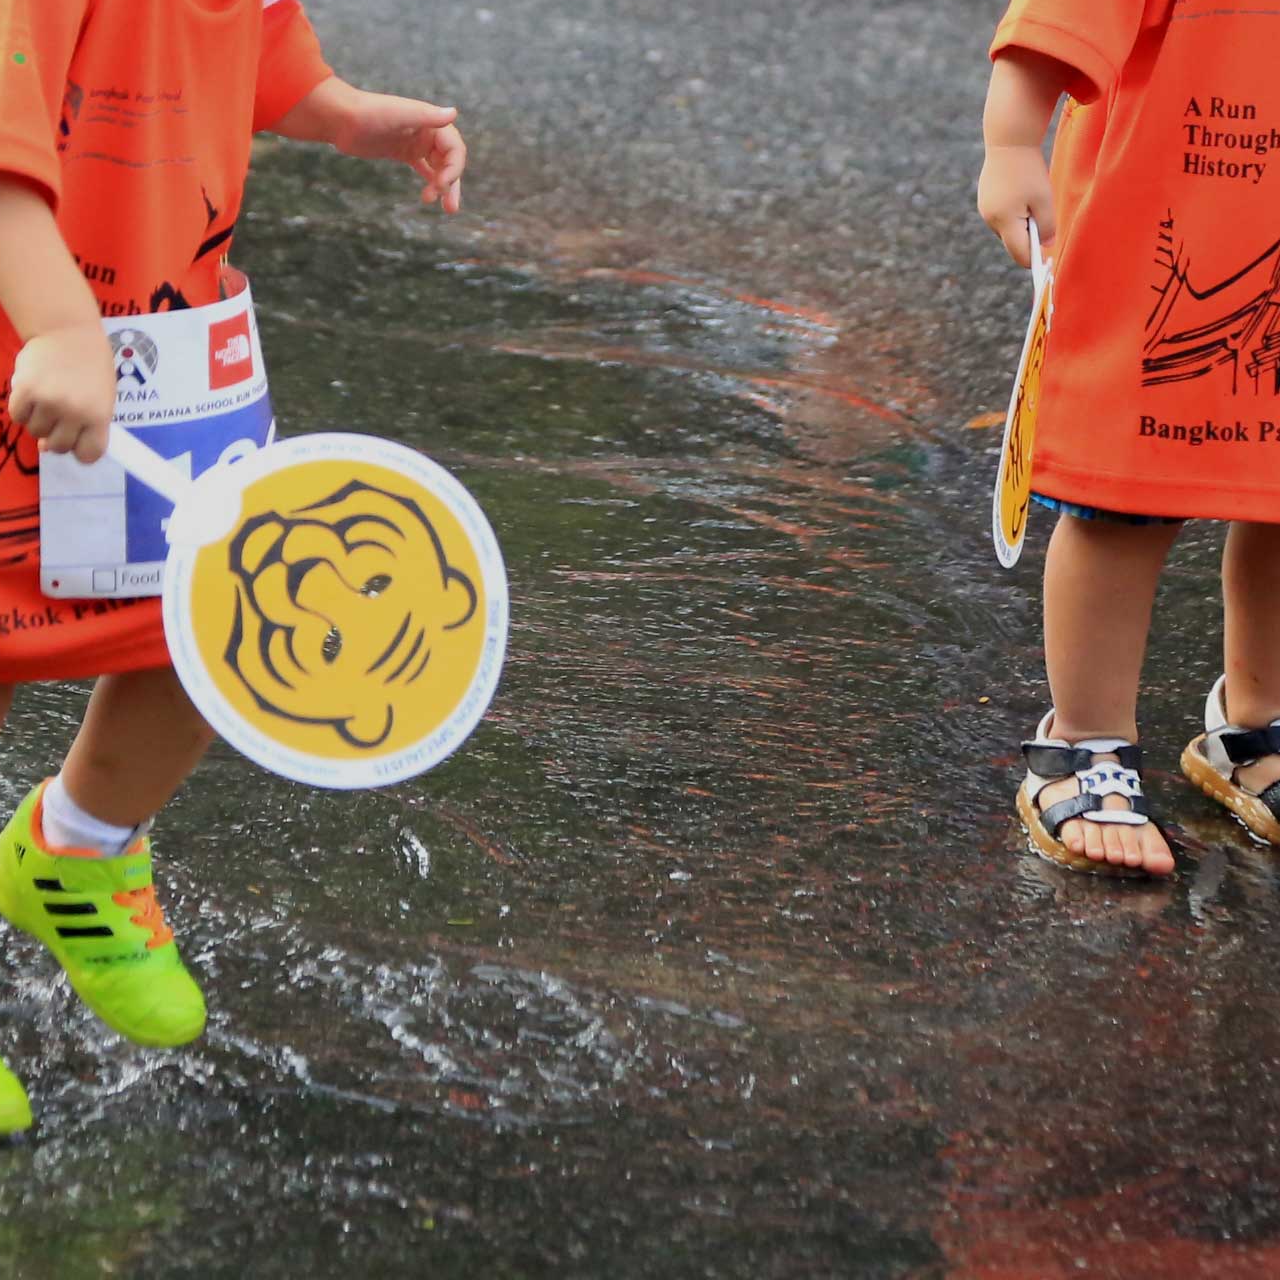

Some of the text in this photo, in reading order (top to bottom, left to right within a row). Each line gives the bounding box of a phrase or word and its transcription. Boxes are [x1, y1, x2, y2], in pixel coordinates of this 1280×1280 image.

[1183, 96, 1257, 120] A Run
[1182, 152, 1267, 185] History
[74, 254, 116, 286] un
[115, 390, 160, 402] TANA
[148, 407, 191, 419] PATANA
[195, 398, 234, 414] SCHOOL
[1138, 415, 1249, 446] Bangkok
[120, 570, 160, 586] Food
